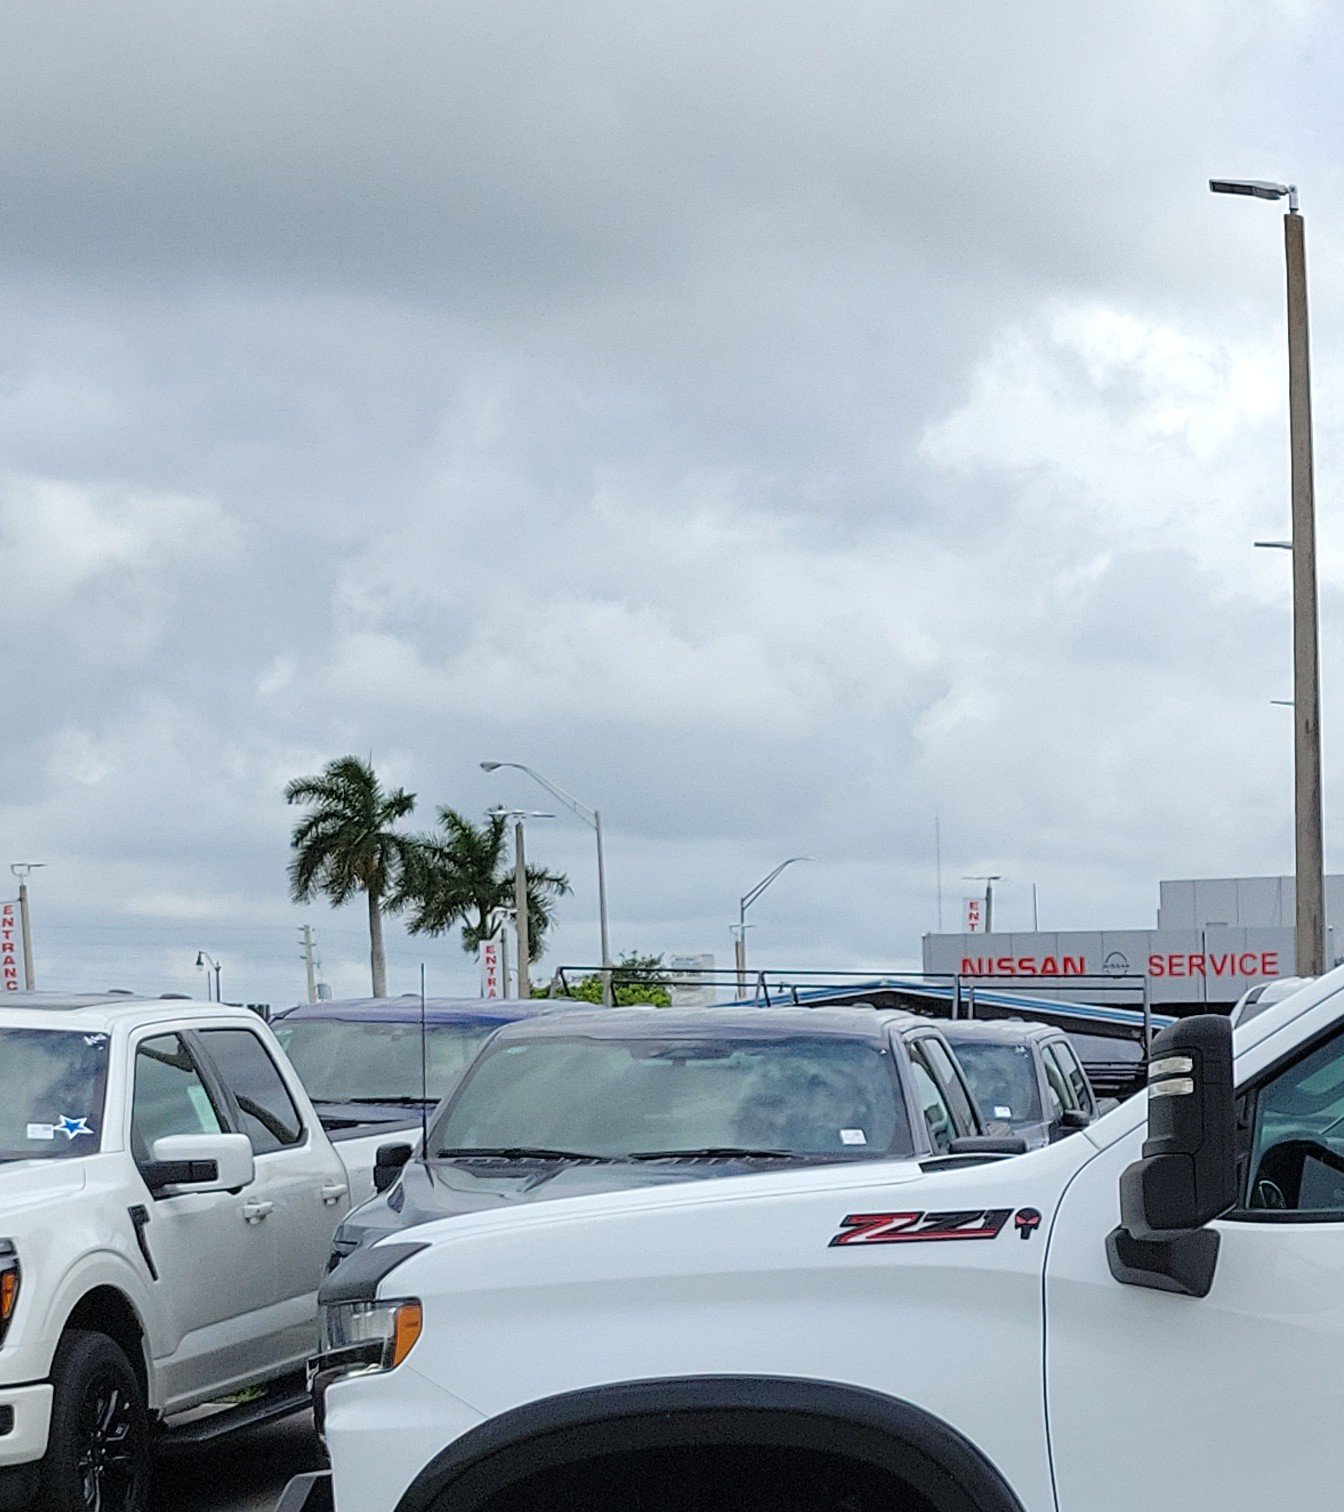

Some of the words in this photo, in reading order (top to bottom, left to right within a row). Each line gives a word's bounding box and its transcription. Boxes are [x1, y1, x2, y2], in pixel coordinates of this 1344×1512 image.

[961, 956, 1085, 974] NISSAN
[1148, 952, 1278, 976] SERVICE
[828, 1208, 1014, 1247] Z71
